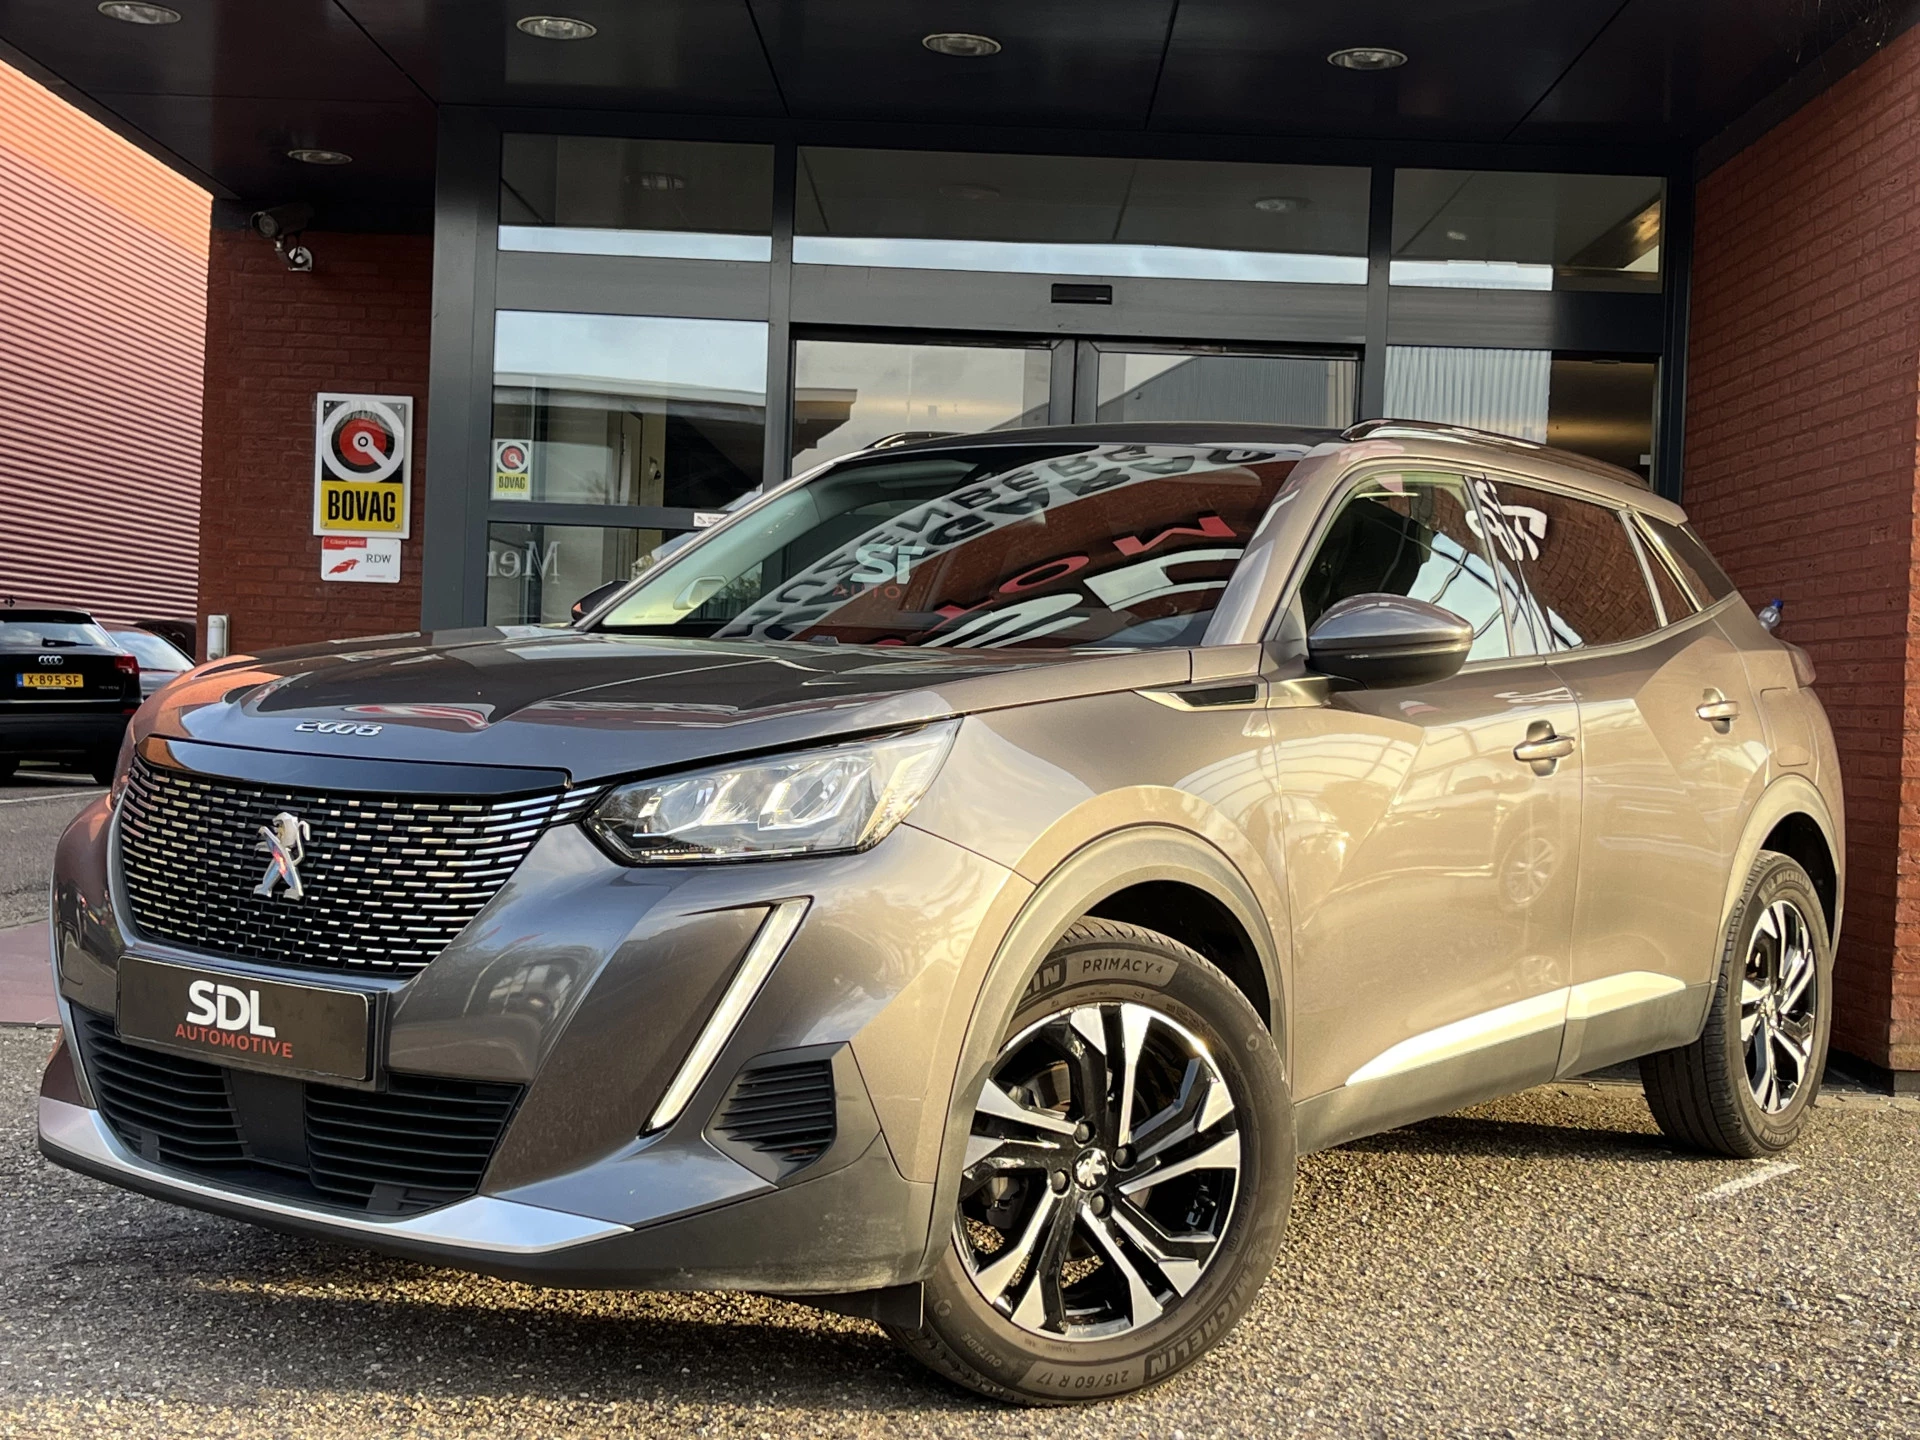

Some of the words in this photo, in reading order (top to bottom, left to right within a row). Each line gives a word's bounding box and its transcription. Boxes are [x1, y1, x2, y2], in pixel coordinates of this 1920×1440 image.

[498, 476, 526, 490] BOVAG
[328, 490, 396, 522] BOVAG
[366, 554, 392, 564] RDW
[294, 720, 383, 736] 2008
[1082, 957, 1154, 974] PRIMACY
[1155, 965, 1164, 973] 4
[186, 980, 276, 1038] SDL
[175, 1024, 293, 1058] AUTOMOTIVE
[1150, 1268, 1254, 1377] MICHELIN
[961, 1333, 1002, 1367] OUTSIDE
[1036, 1373, 1055, 1386] 17
[1058, 1378, 1071, 1387] R
[1075, 1370, 1129, 1389] 215/60
